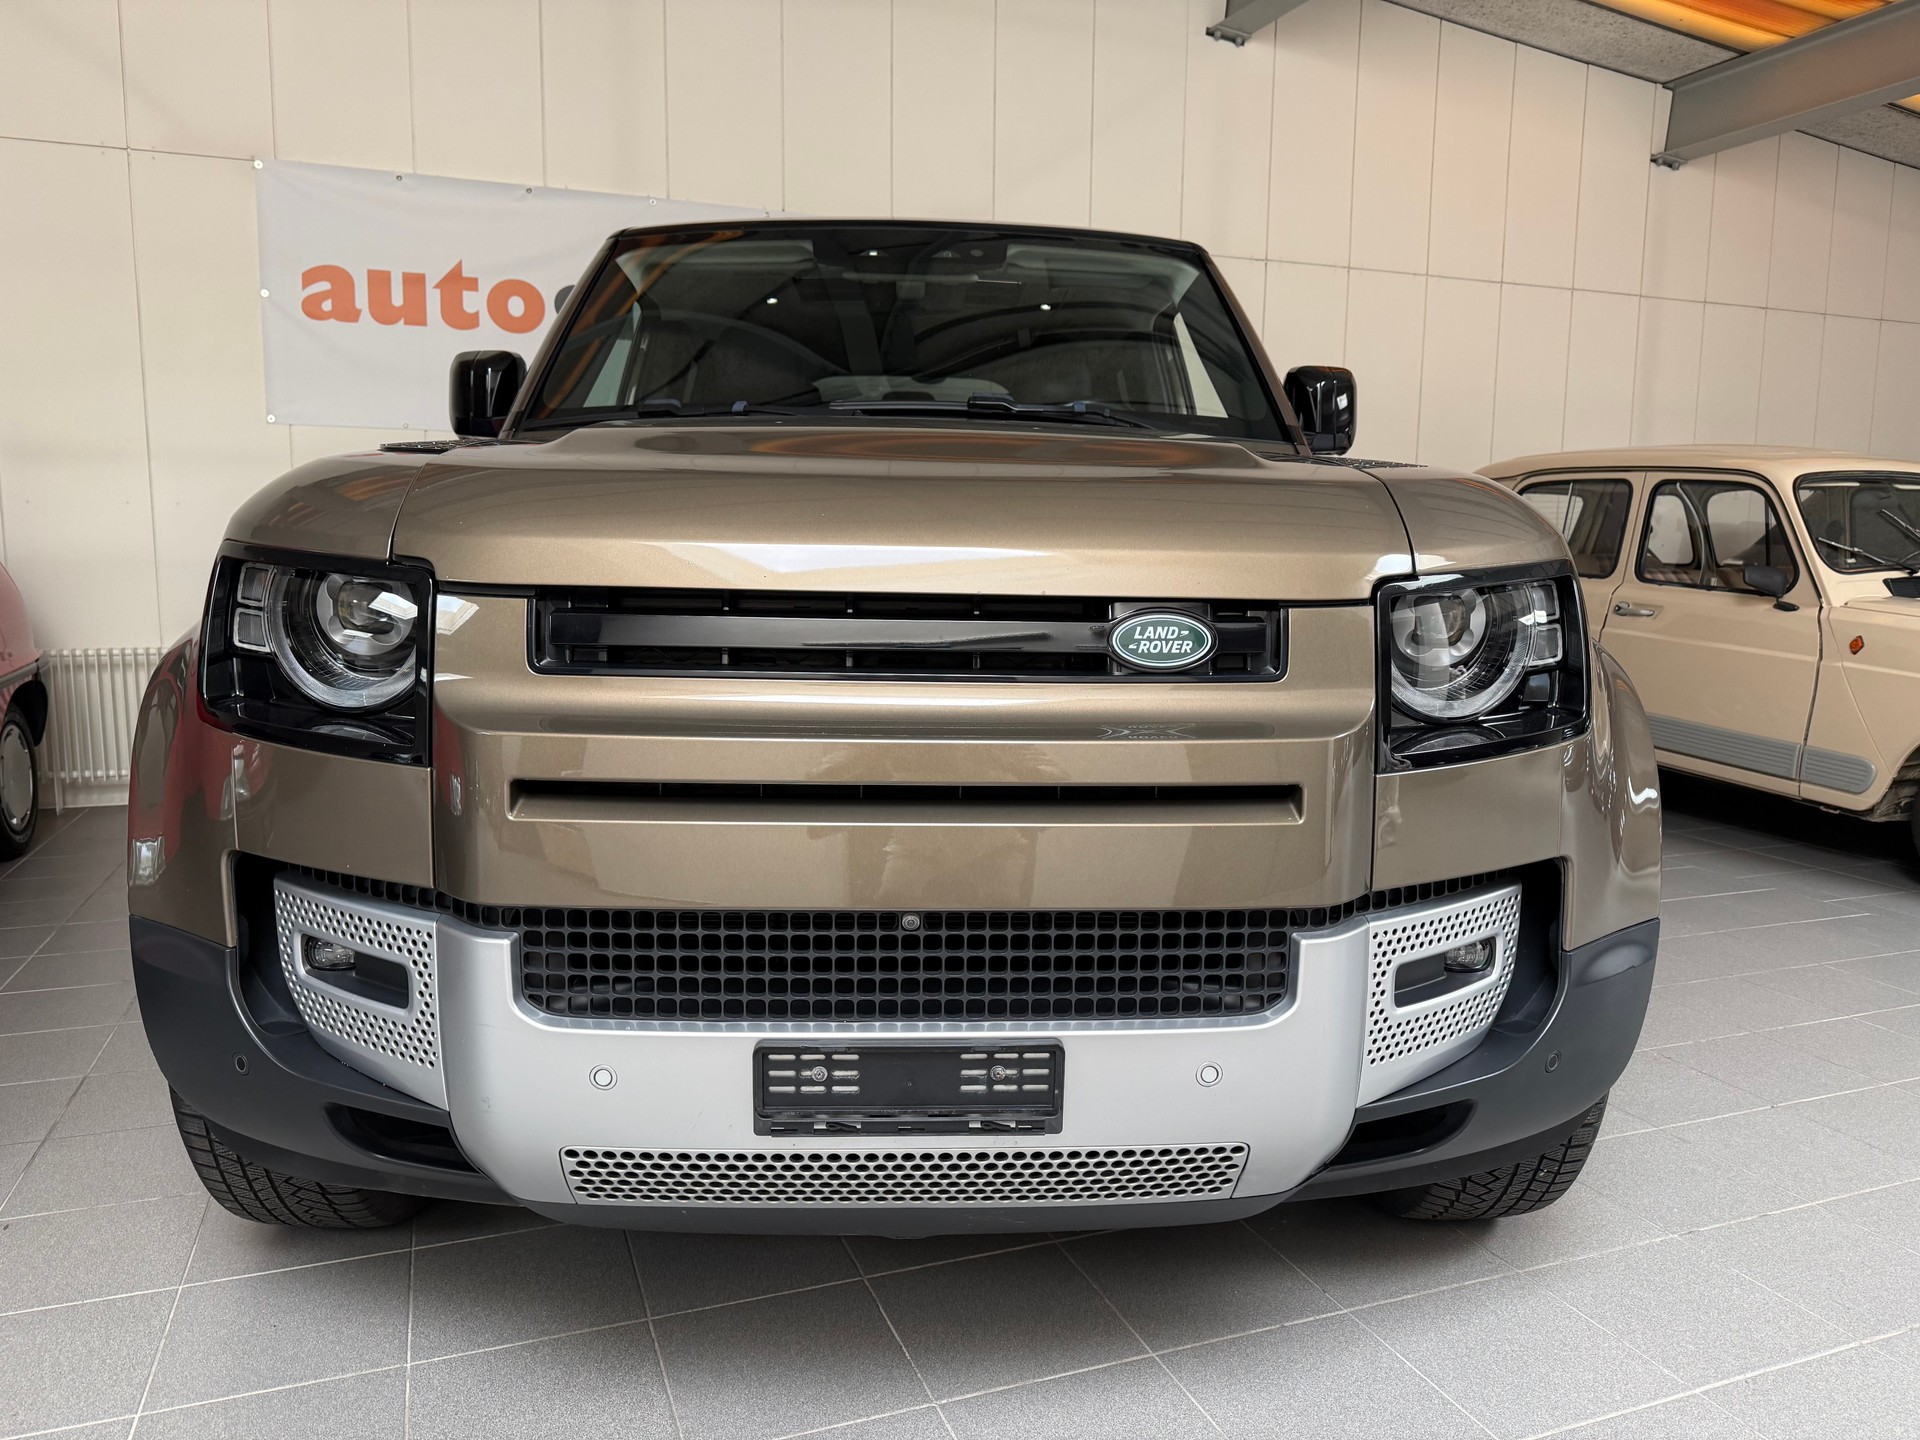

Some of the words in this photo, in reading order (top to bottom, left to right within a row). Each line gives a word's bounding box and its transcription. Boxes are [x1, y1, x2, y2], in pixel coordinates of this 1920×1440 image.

[301, 259, 575, 334] auto
[1134, 626, 1179, 640] LAND
[1138, 640, 1193, 654] ROVER
